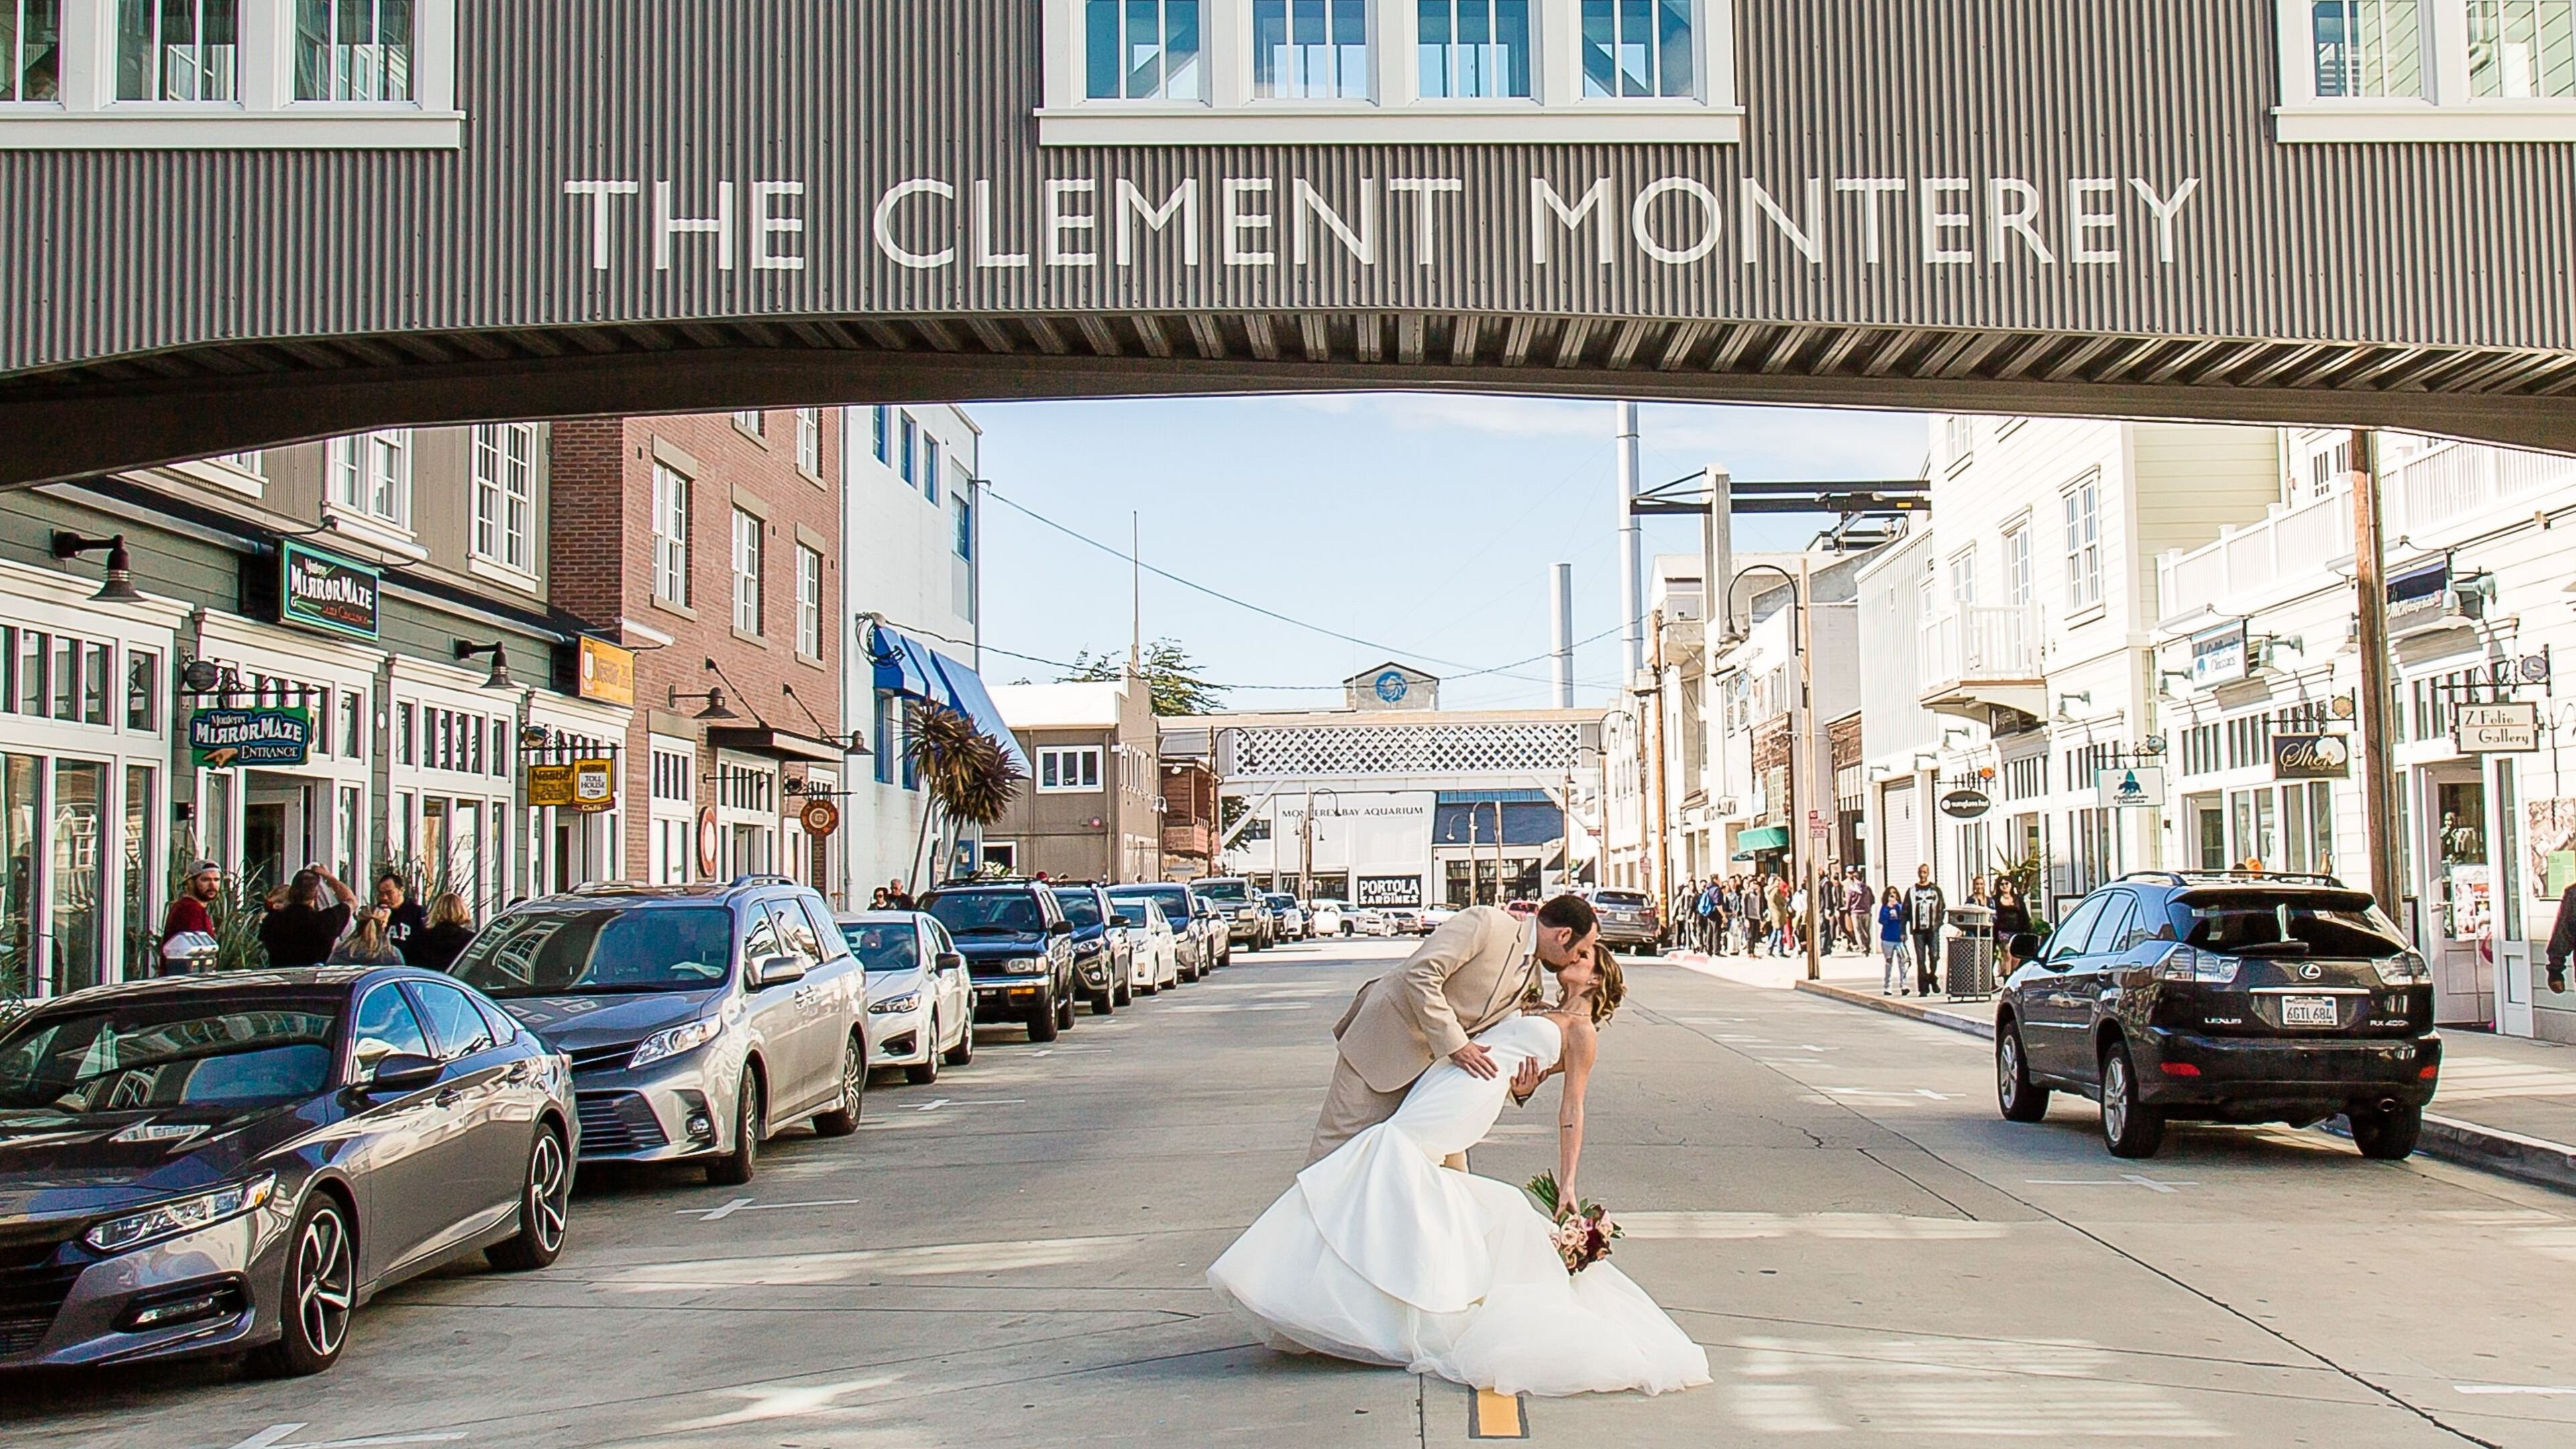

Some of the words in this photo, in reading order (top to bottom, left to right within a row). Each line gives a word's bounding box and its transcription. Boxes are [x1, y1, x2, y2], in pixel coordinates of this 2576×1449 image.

[564, 180, 804, 270] THE
[873, 177, 1462, 268] CLEMENT
[1531, 176, 2200, 264] MONTEREY
[2465, 710, 2475, 725] Z
[2481, 710, 2514, 724] Folio
[2478, 728, 2528, 745] Gallery
[241, 745, 299, 759] ENTRANCE
[1364, 807, 1424, 816] AQUARIUM
[1358, 879, 1420, 897] PORTOLA
[1358, 895, 1419, 905] SARDINES
